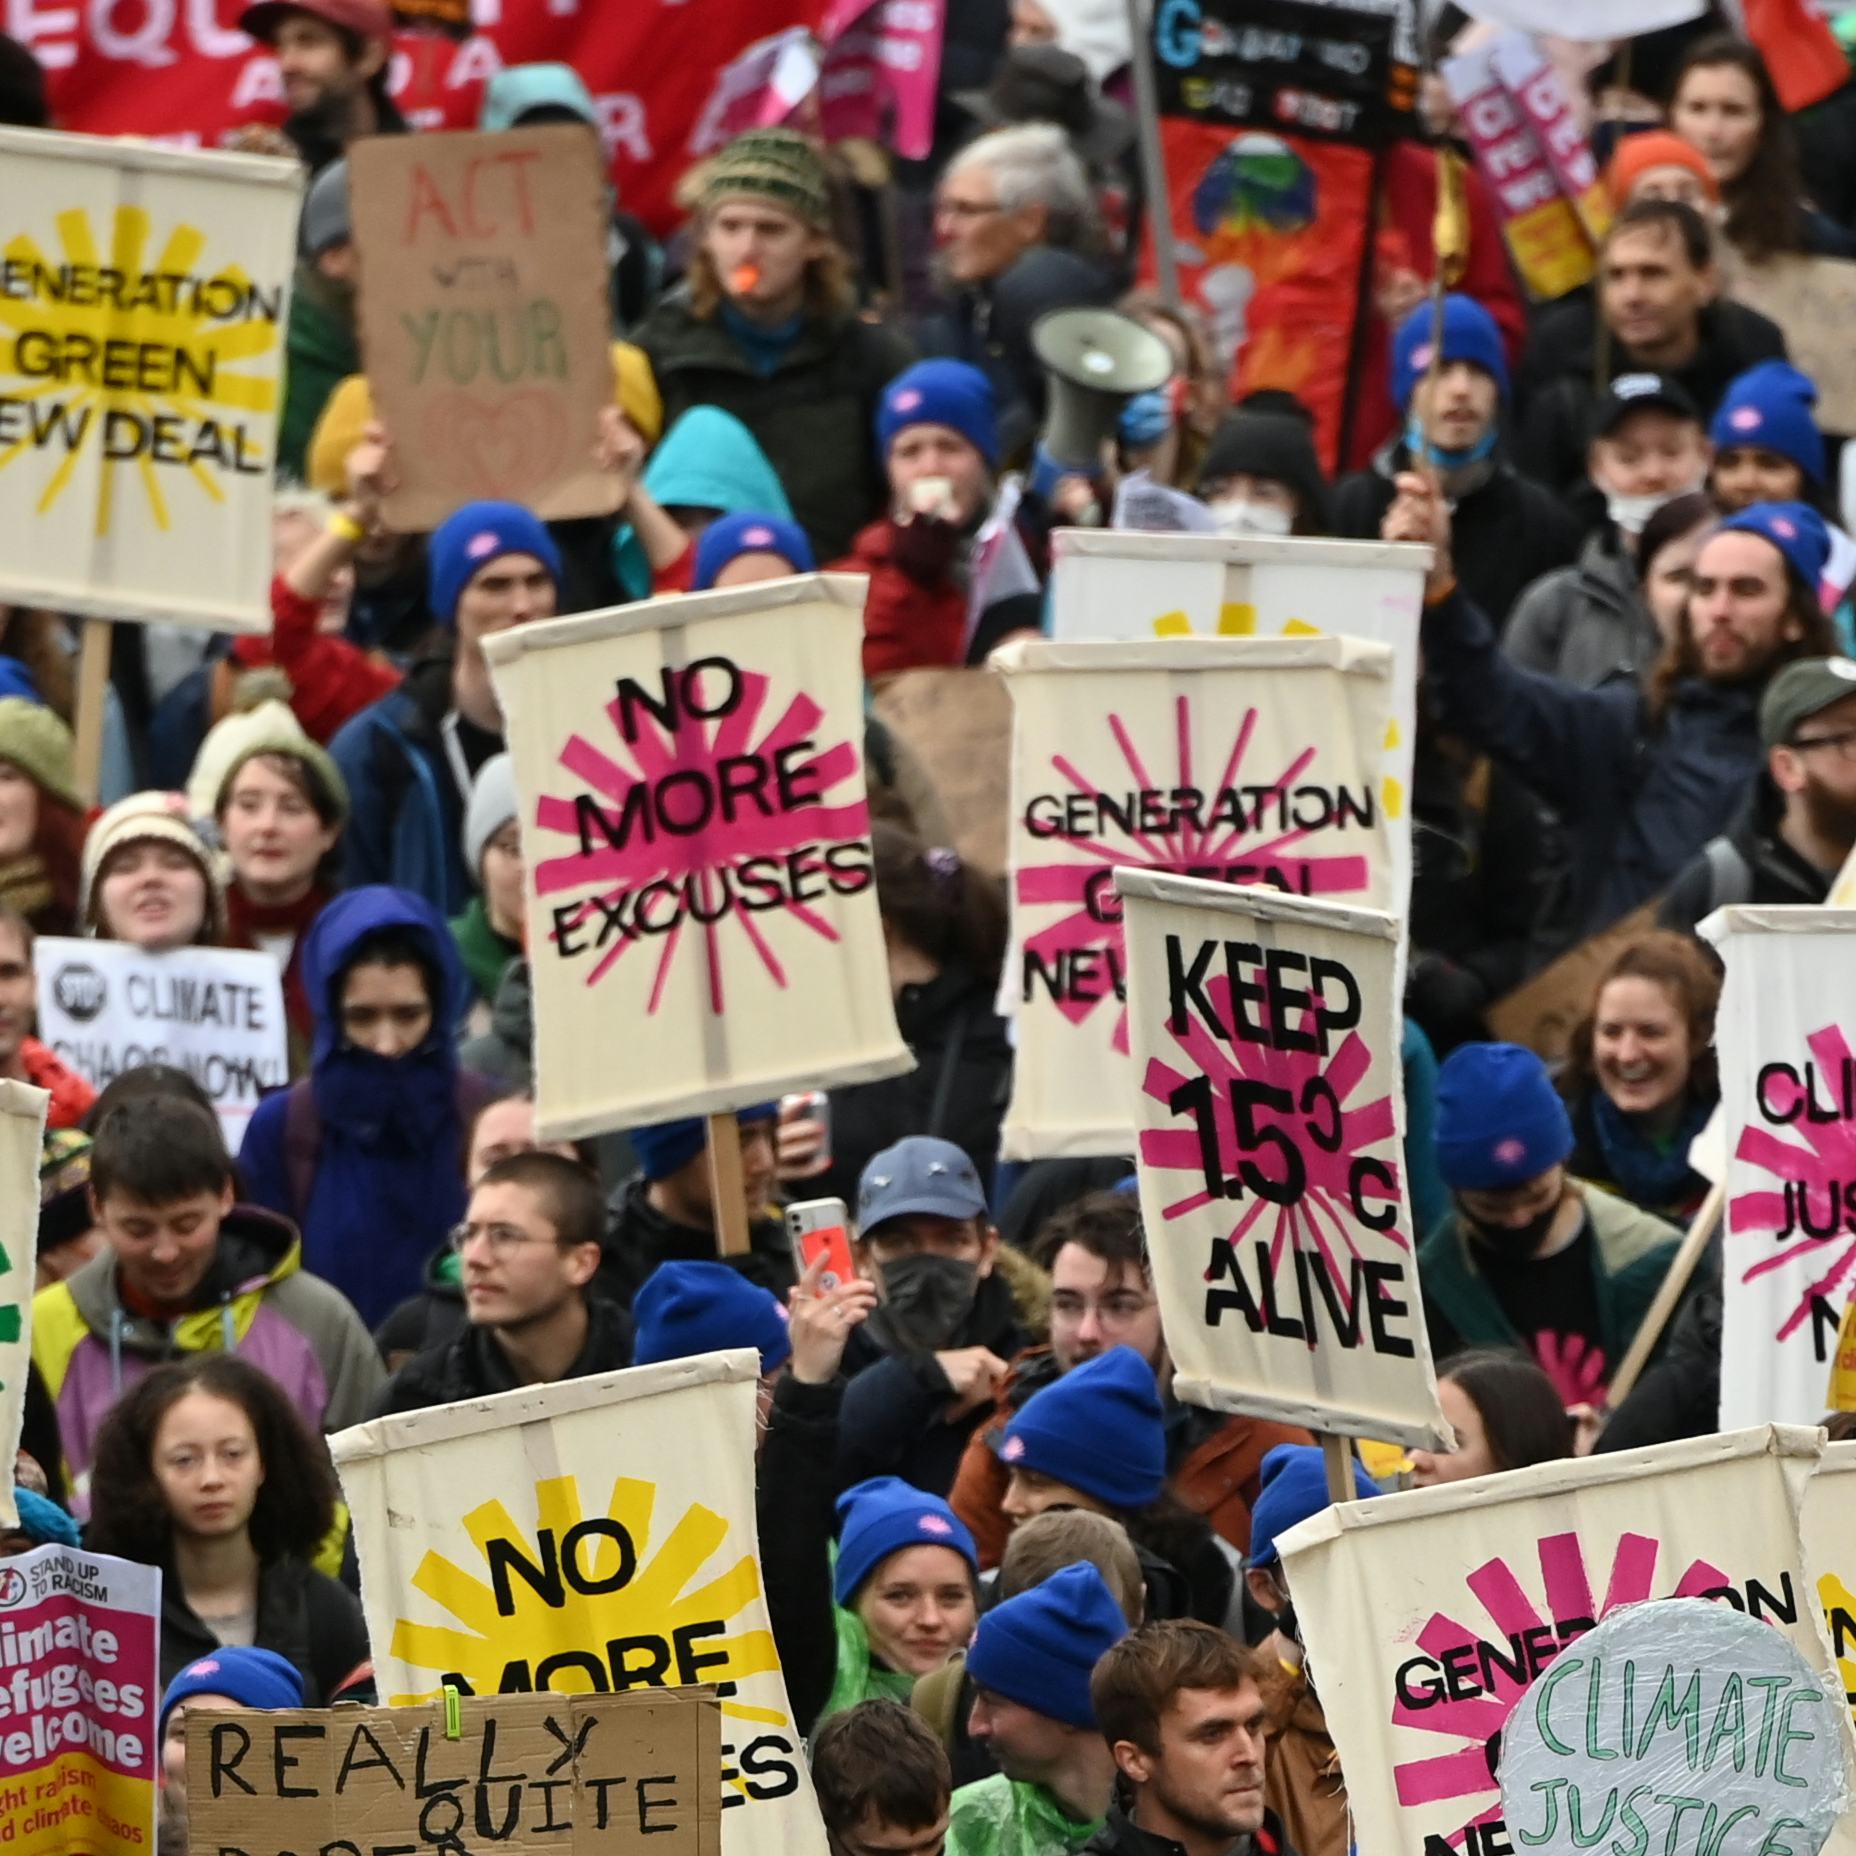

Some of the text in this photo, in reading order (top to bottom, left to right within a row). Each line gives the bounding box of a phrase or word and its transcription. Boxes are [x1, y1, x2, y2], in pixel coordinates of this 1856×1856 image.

[404, 153, 541, 244] ACT
[13, 331, 217, 397] GREEN
[400, 299, 570, 383] YOUR
[101, 410, 265, 475] DEAL
[616, 655, 744, 746] NO
[573, 739, 824, 858] MORE
[1025, 784, 1375, 838] GENERATION
[554, 840, 873, 960] EXCUSES
[126, 974, 268, 1031] CLIMATE
[1164, 933, 1363, 1058] KEEP
[1204, 1236, 1416, 1360] ALIVE
[30, 1556, 99, 1581] STAND UP
[33, 1576, 108, 1602] TO RACISM
[485, 1518, 638, 1618] NO
[211, 1714, 599, 1798] REALLY
[1535, 1658, 1823, 1790] CLIMATE
[23, 1795, 92, 1834] climate
[418, 1775, 678, 1845] QUITE
